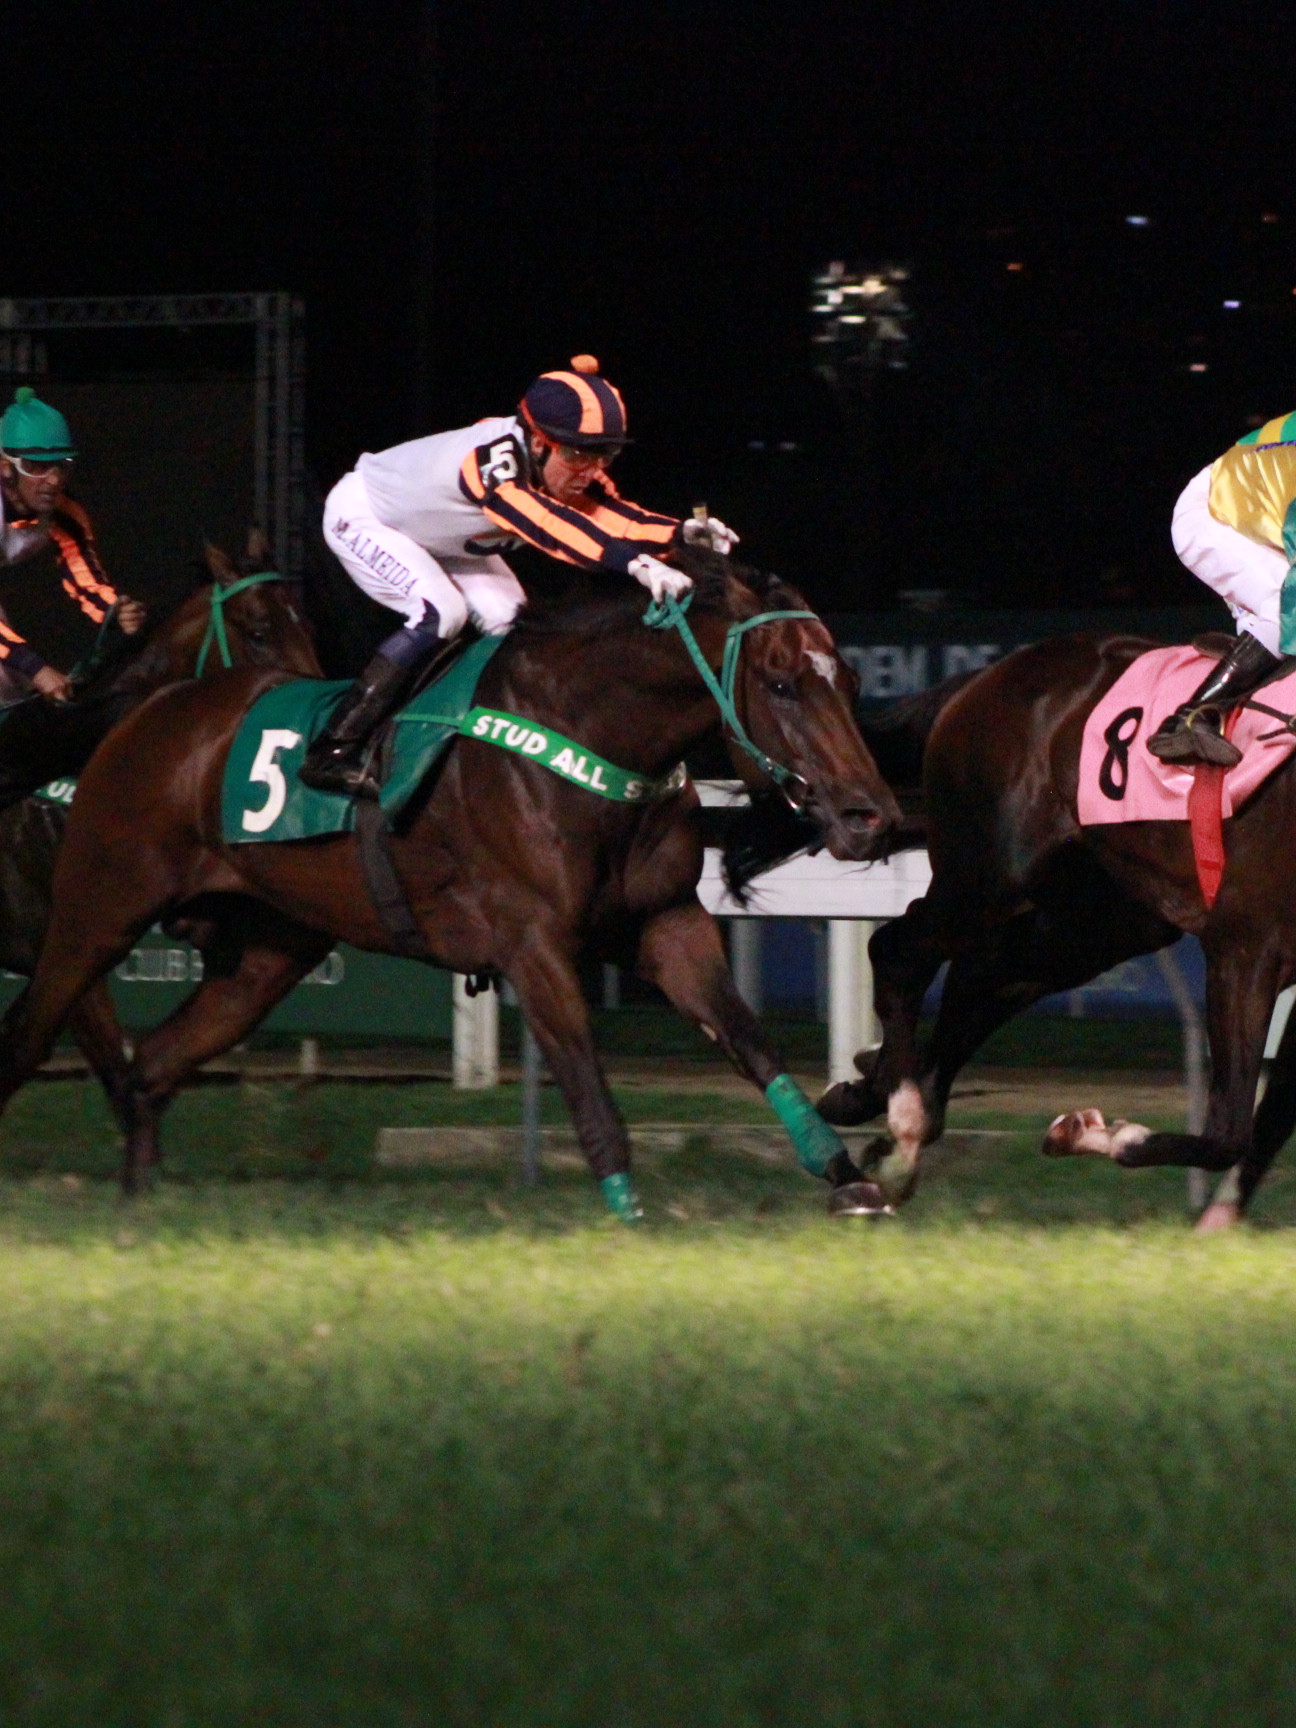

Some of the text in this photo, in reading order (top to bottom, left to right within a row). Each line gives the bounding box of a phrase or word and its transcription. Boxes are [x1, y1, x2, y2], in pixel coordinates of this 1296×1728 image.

[241, 728, 304, 833] 5
[472, 715, 548, 755] STUD
[549, 747, 608, 791] ALL
[1099, 706, 1144, 801] 8
